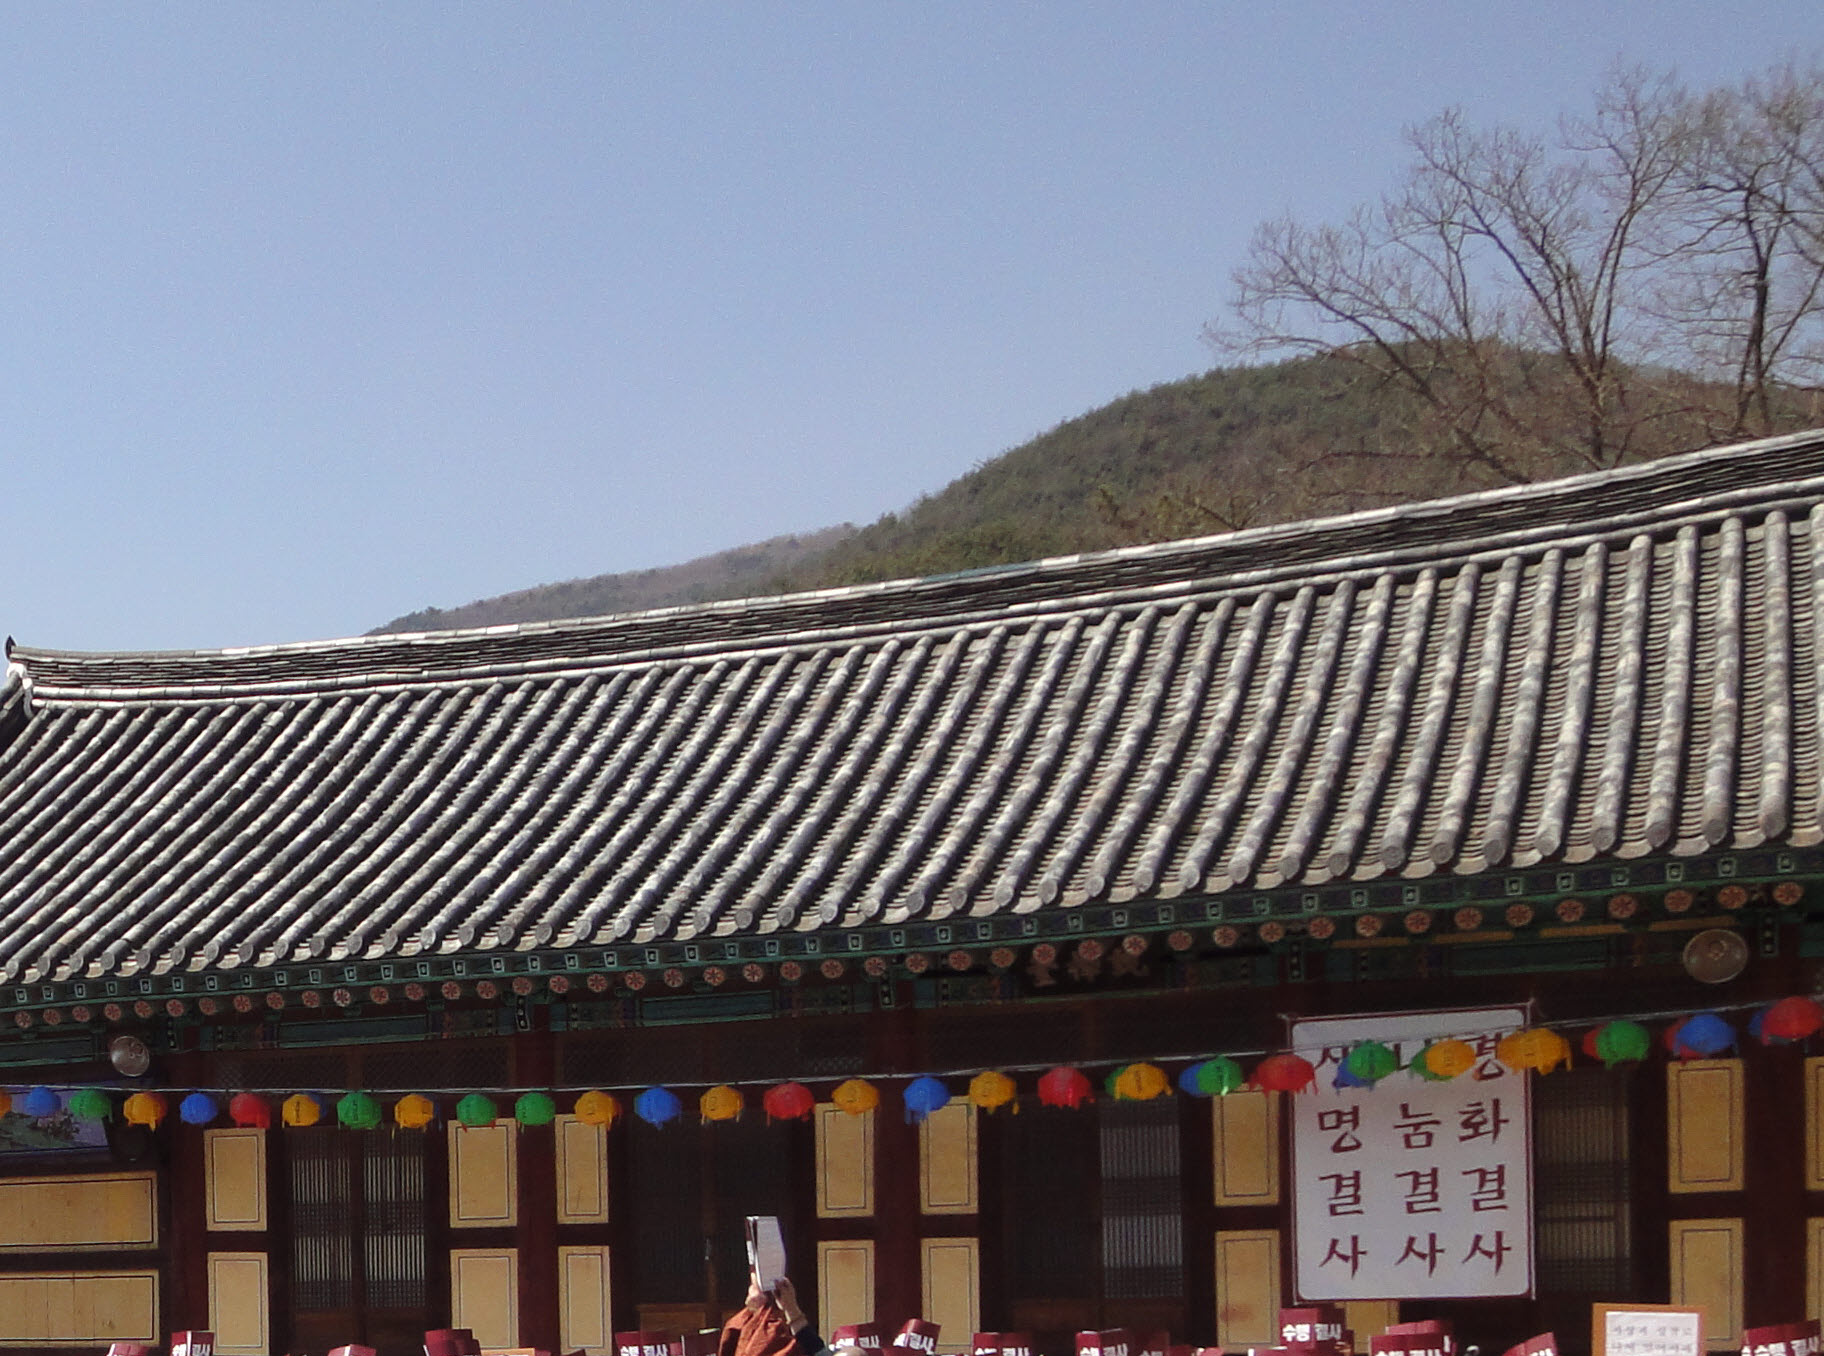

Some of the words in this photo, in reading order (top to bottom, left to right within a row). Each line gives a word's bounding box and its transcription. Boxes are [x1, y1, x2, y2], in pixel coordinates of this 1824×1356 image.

[1282, 1323, 1310, 1343] 수행
[1314, 1322, 1342, 1341] 결사
[909, 1334, 934, 1352] 결사
